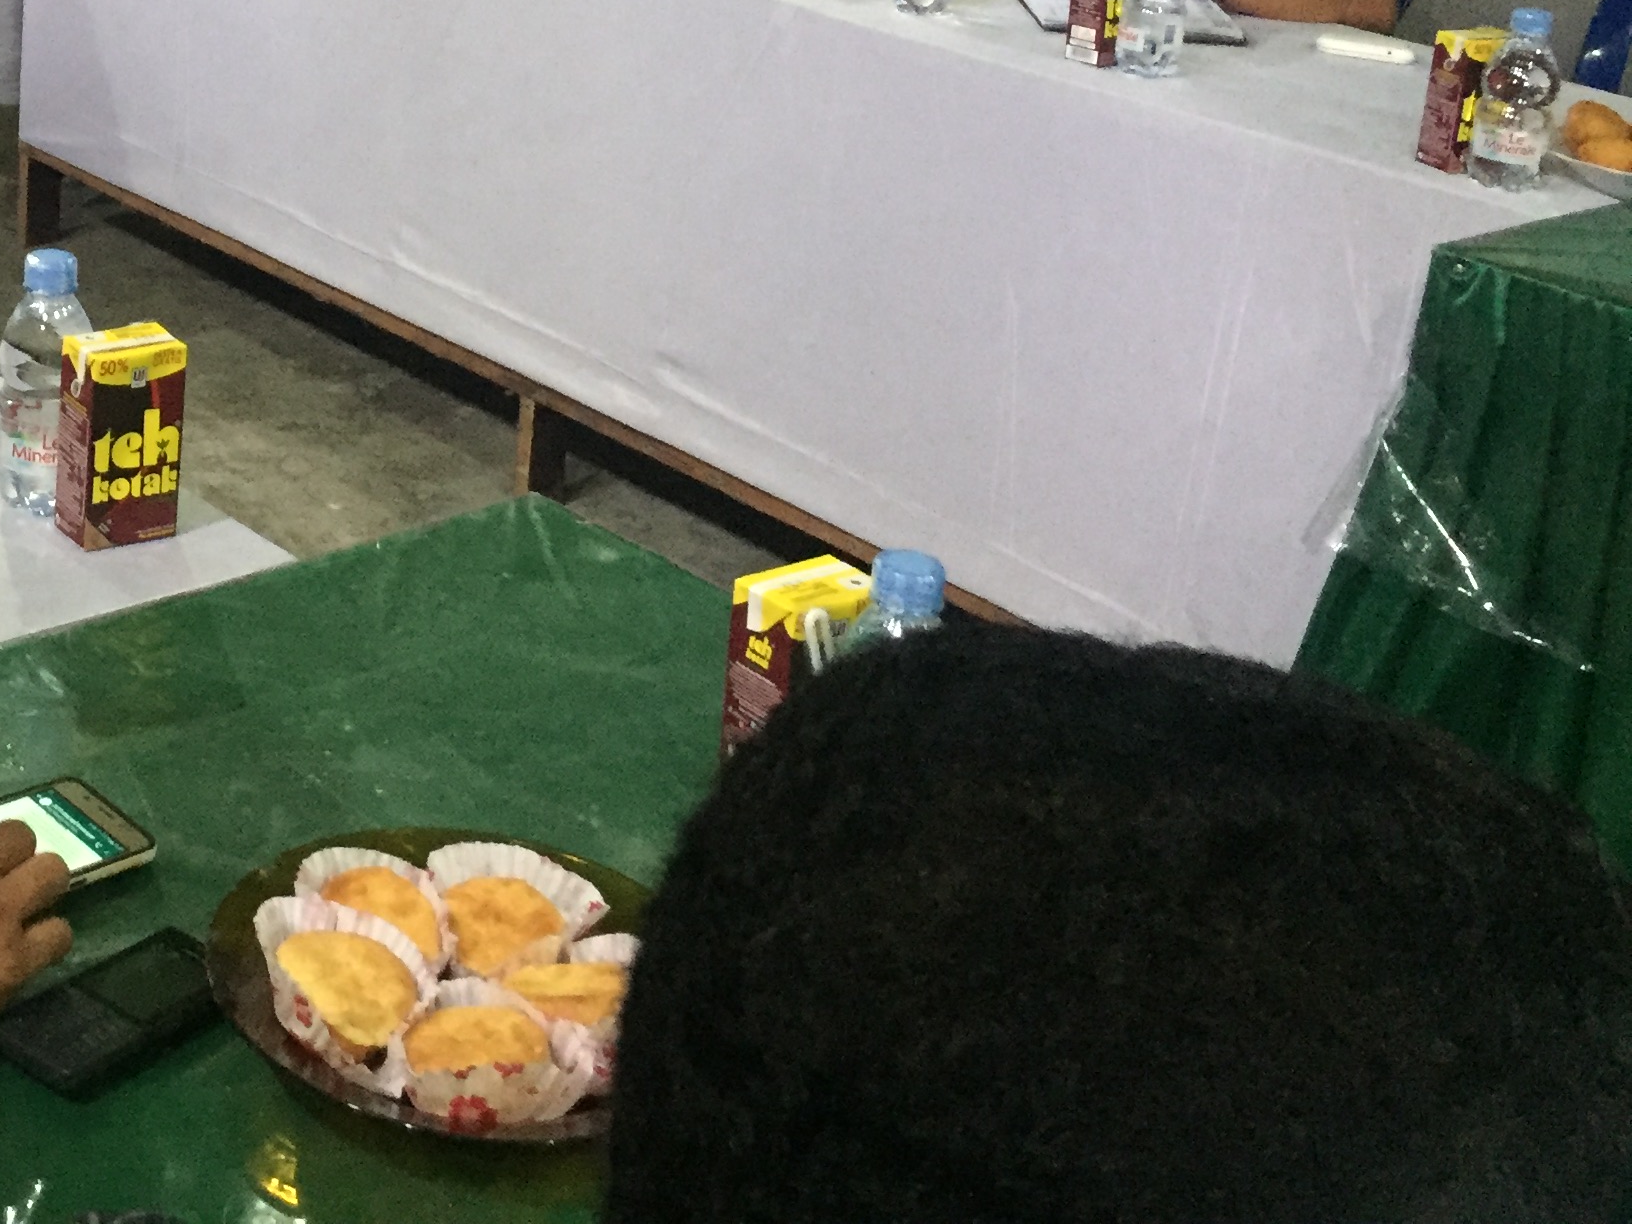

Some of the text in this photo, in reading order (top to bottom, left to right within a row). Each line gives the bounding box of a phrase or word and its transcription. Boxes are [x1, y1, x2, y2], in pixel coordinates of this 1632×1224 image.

[98, 359, 129, 377] 50%
[12, 442, 58, 464] Miner
[93, 408, 180, 473] teh
[91, 465, 177, 505] kotak
